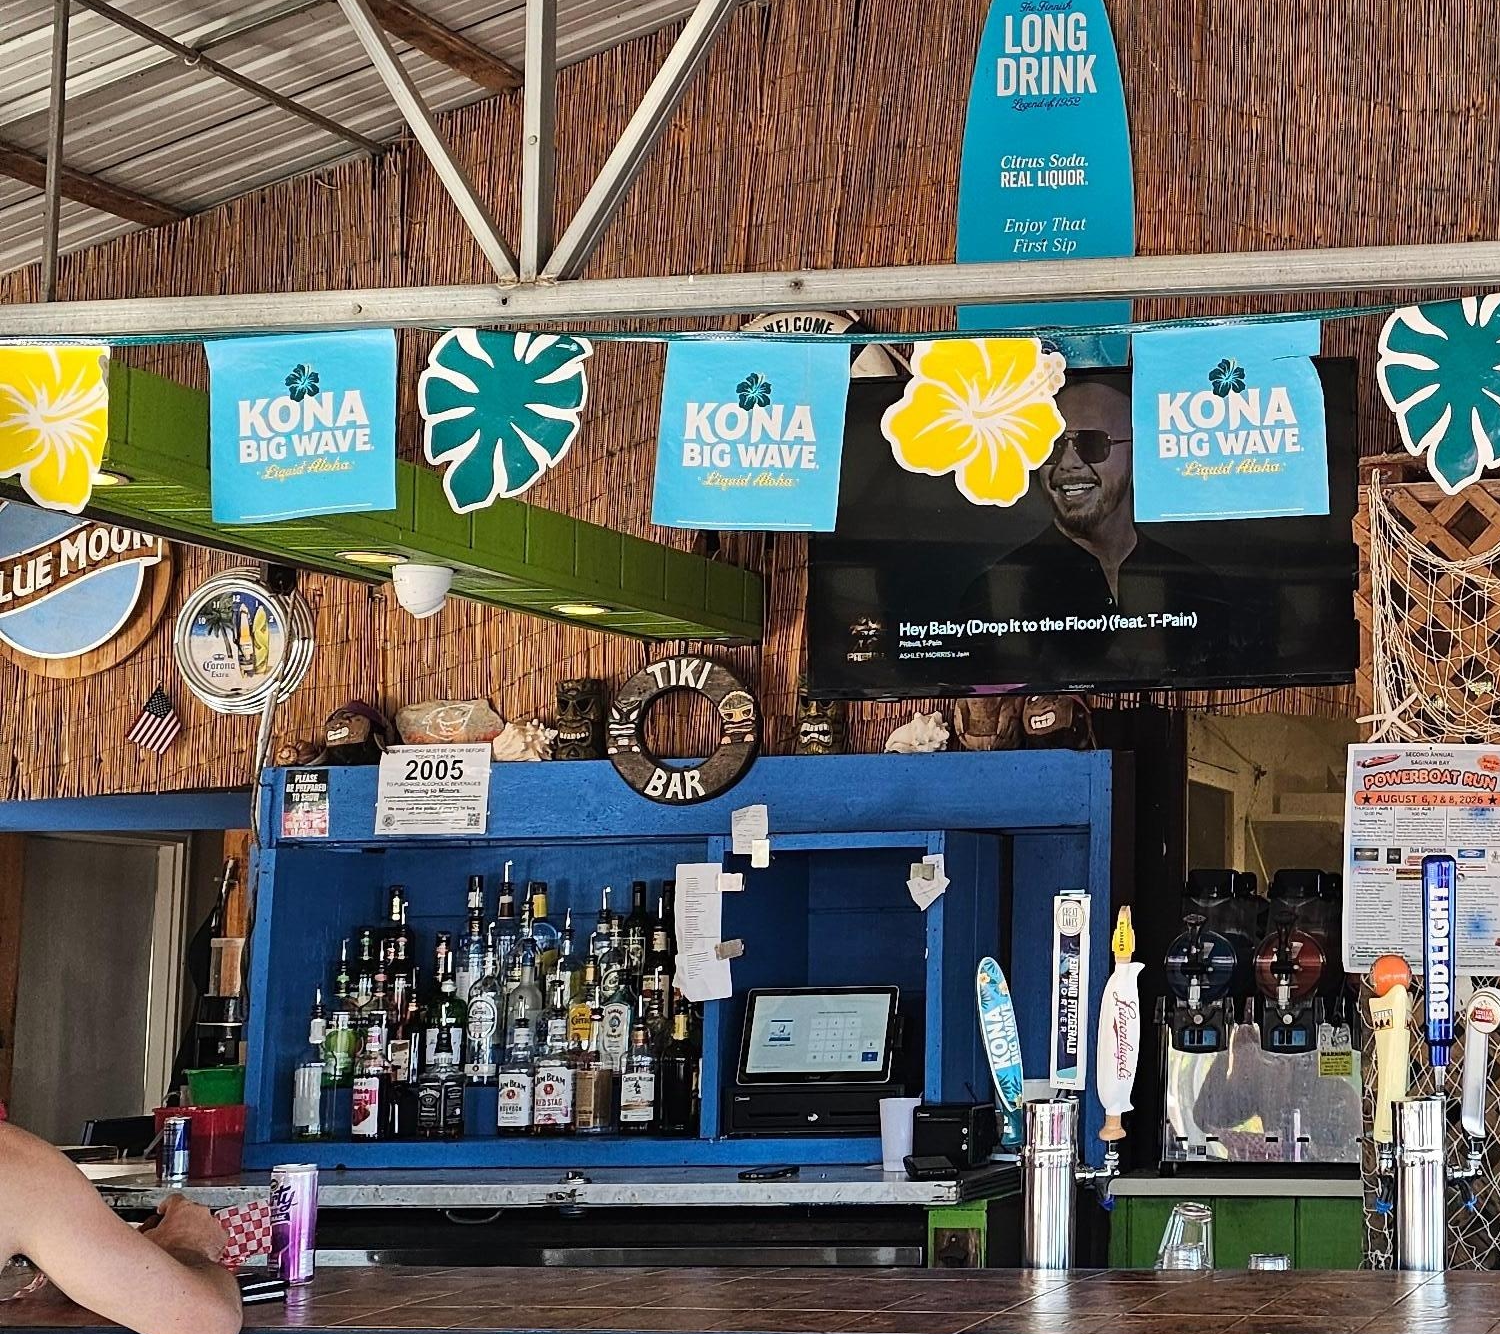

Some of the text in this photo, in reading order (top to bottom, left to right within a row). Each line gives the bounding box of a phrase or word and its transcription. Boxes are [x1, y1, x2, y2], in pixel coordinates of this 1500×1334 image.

[1004, 12, 1087, 54] LONG
[996, 54, 1098, 97] DRINK
[1000, 153, 1089, 169] Citrus Soda.
[1000, 169, 1089, 188] REAL LIQUOR.
[1003, 217, 1087, 235] Enjoy That
[1012, 237, 1078, 255] First Sip
[238, 390, 371, 437] KONA
[1158, 386, 1295, 428] KONA
[684, 403, 814, 442] KONA
[239, 428, 374, 464] BIG WAVE
[682, 443, 819, 469] BIG WAVE
[1158, 428, 1305, 458] BIG WAVE
[262, 460, 350, 480] Liquid Aloha
[1181, 459, 1281, 477] Liquid Aloha
[0, 552, 53, 604] LUE
[899, 613, 1198, 638] Hey Baby (Drop It to the Floor) (feat. T-Pain)
[202, 660, 236, 672] Corona
[646, 658, 712, 690] TIKI
[404, 759, 464, 781] 2005
[644, 768, 706, 800] BAR
[1363, 768, 1497, 792] POWERBOAT RUN
[1375, 794, 1484, 805] AUGUST 2026
[1429, 883, 1450, 1020] BUD LIGHT
[1059, 978, 1069, 1033] PORTER
[1066, 958, 1080, 1055] EDMUND FITZGERALD
[984, 1009, 1011, 1067] KONA
[545, 1072, 566, 1086] BEAM
[547, 1098, 563, 1107] STAG
